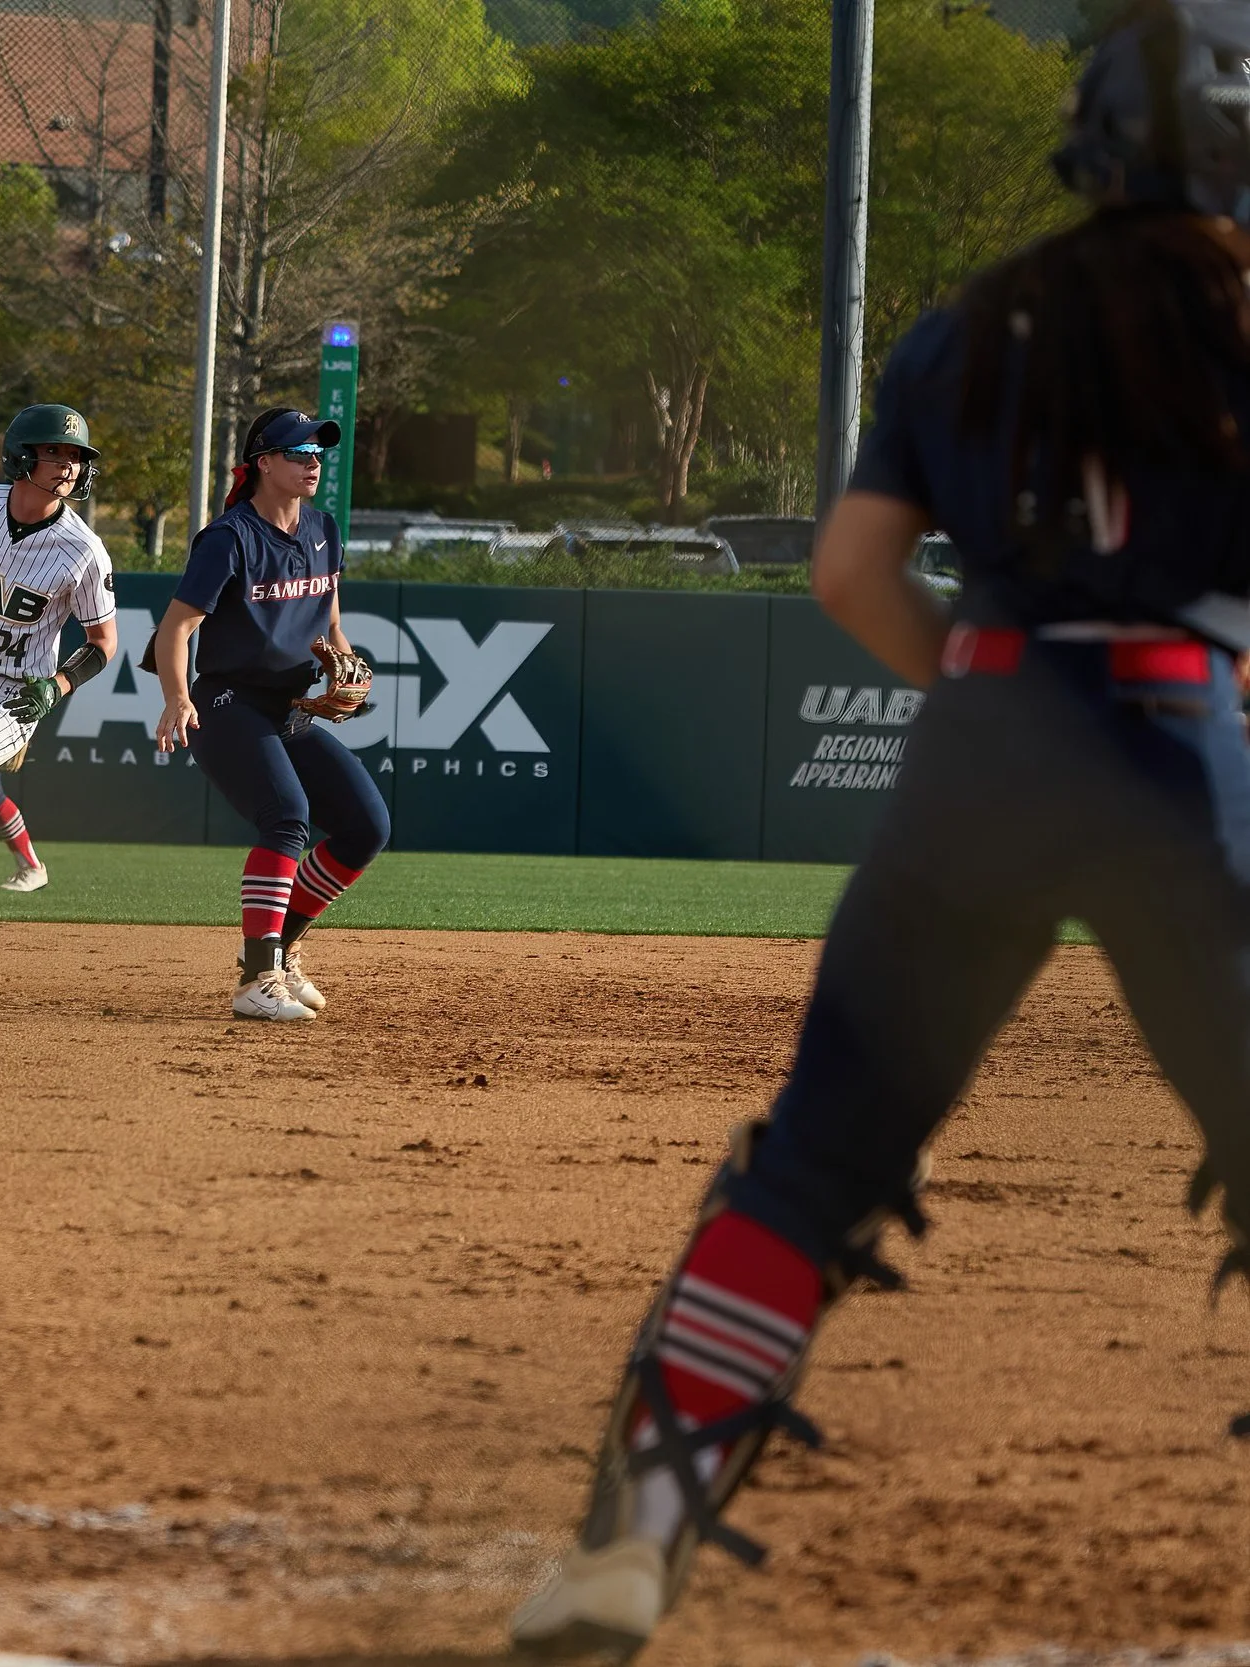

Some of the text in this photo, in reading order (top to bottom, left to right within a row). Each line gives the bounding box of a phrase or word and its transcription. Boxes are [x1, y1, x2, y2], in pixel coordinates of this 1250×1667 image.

[324, 389, 345, 522] EMGENC
[798, 685, 928, 726] UAB
[56, 747, 550, 778] ALABA APHICS
